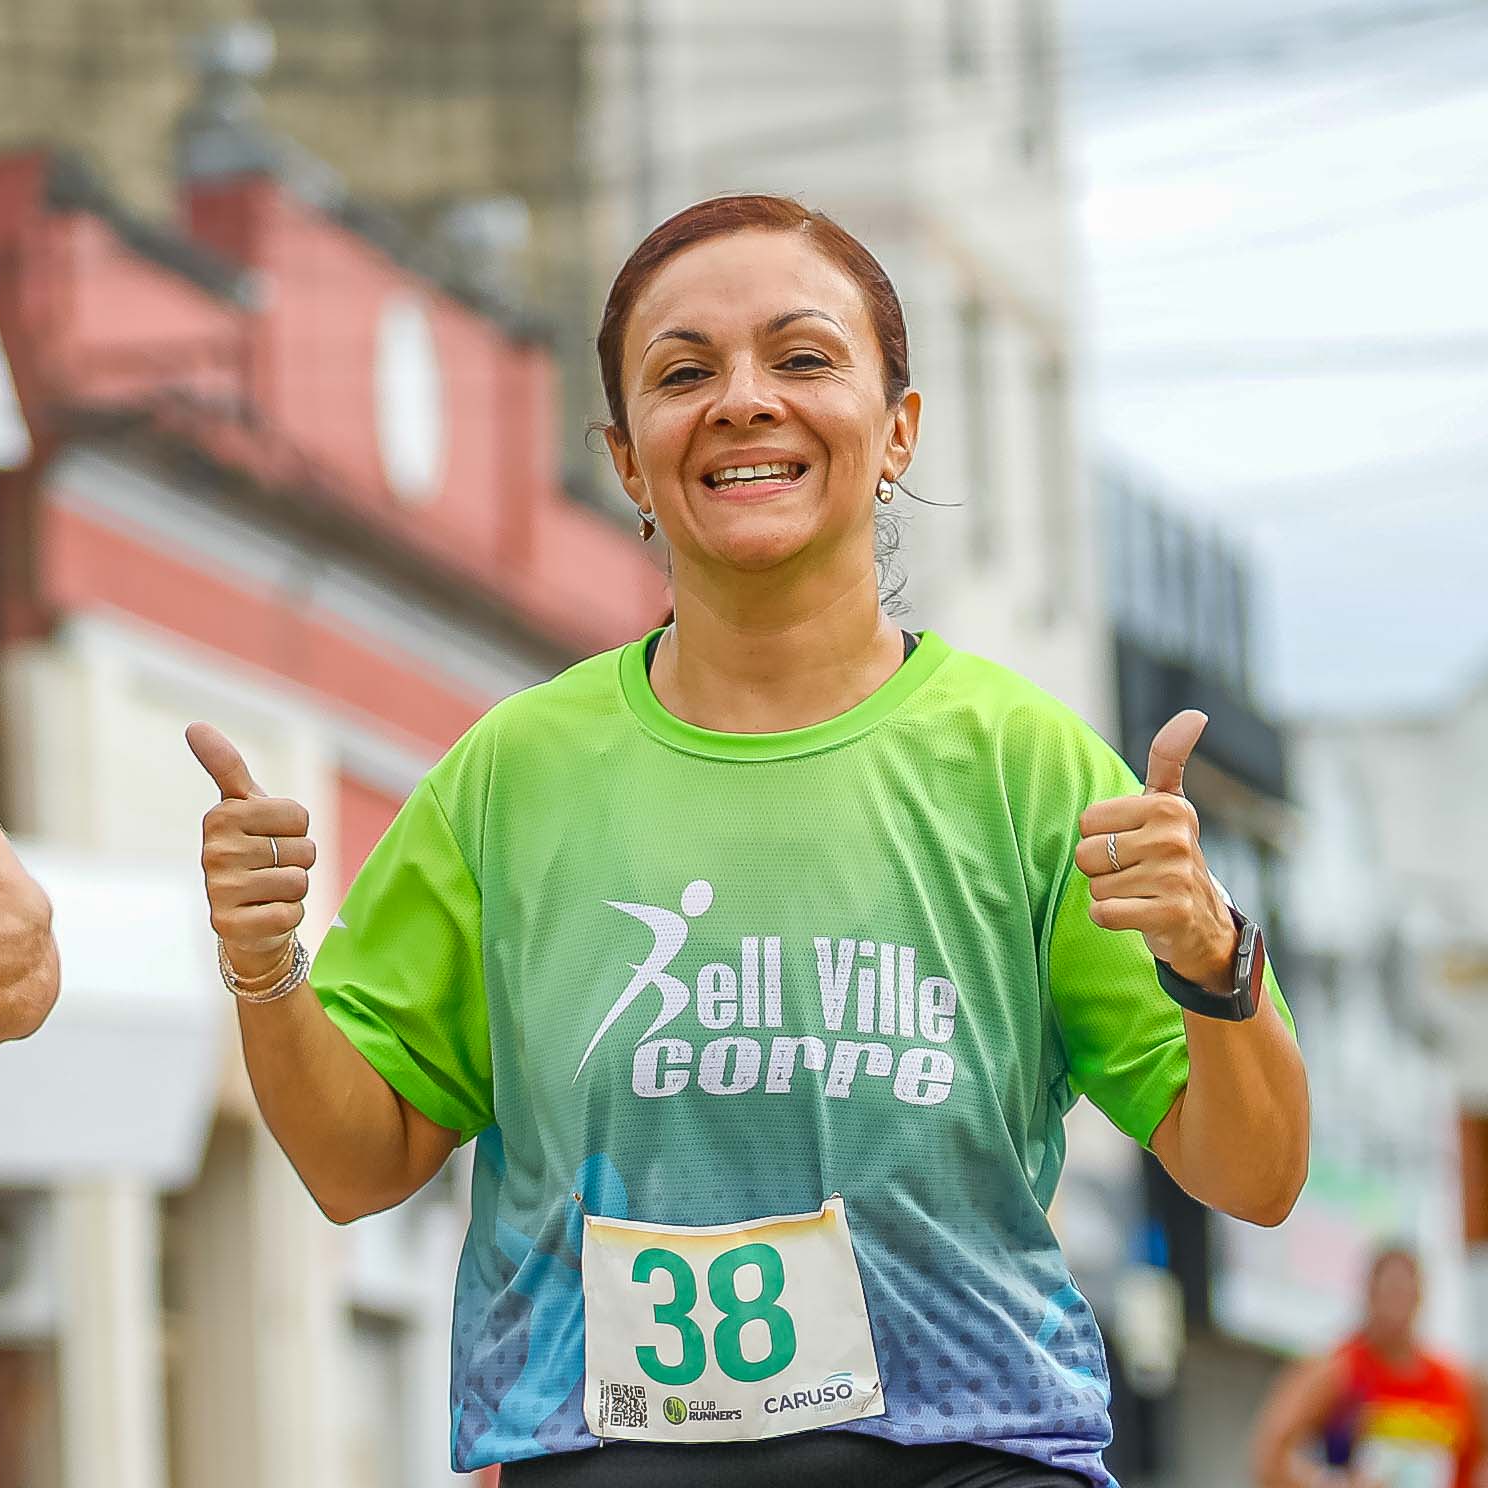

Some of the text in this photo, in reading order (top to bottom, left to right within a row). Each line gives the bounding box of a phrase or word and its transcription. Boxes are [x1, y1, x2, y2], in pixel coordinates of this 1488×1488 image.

[813, 935, 958, 1044] Ville
[631, 1034, 955, 1105] corre
[631, 1243, 798, 1386] 38
[688, 1400, 717, 1411] CLUB
[688, 1409, 743, 1421] RUNNER'S
[764, 1383, 853, 1414] CARUSO
